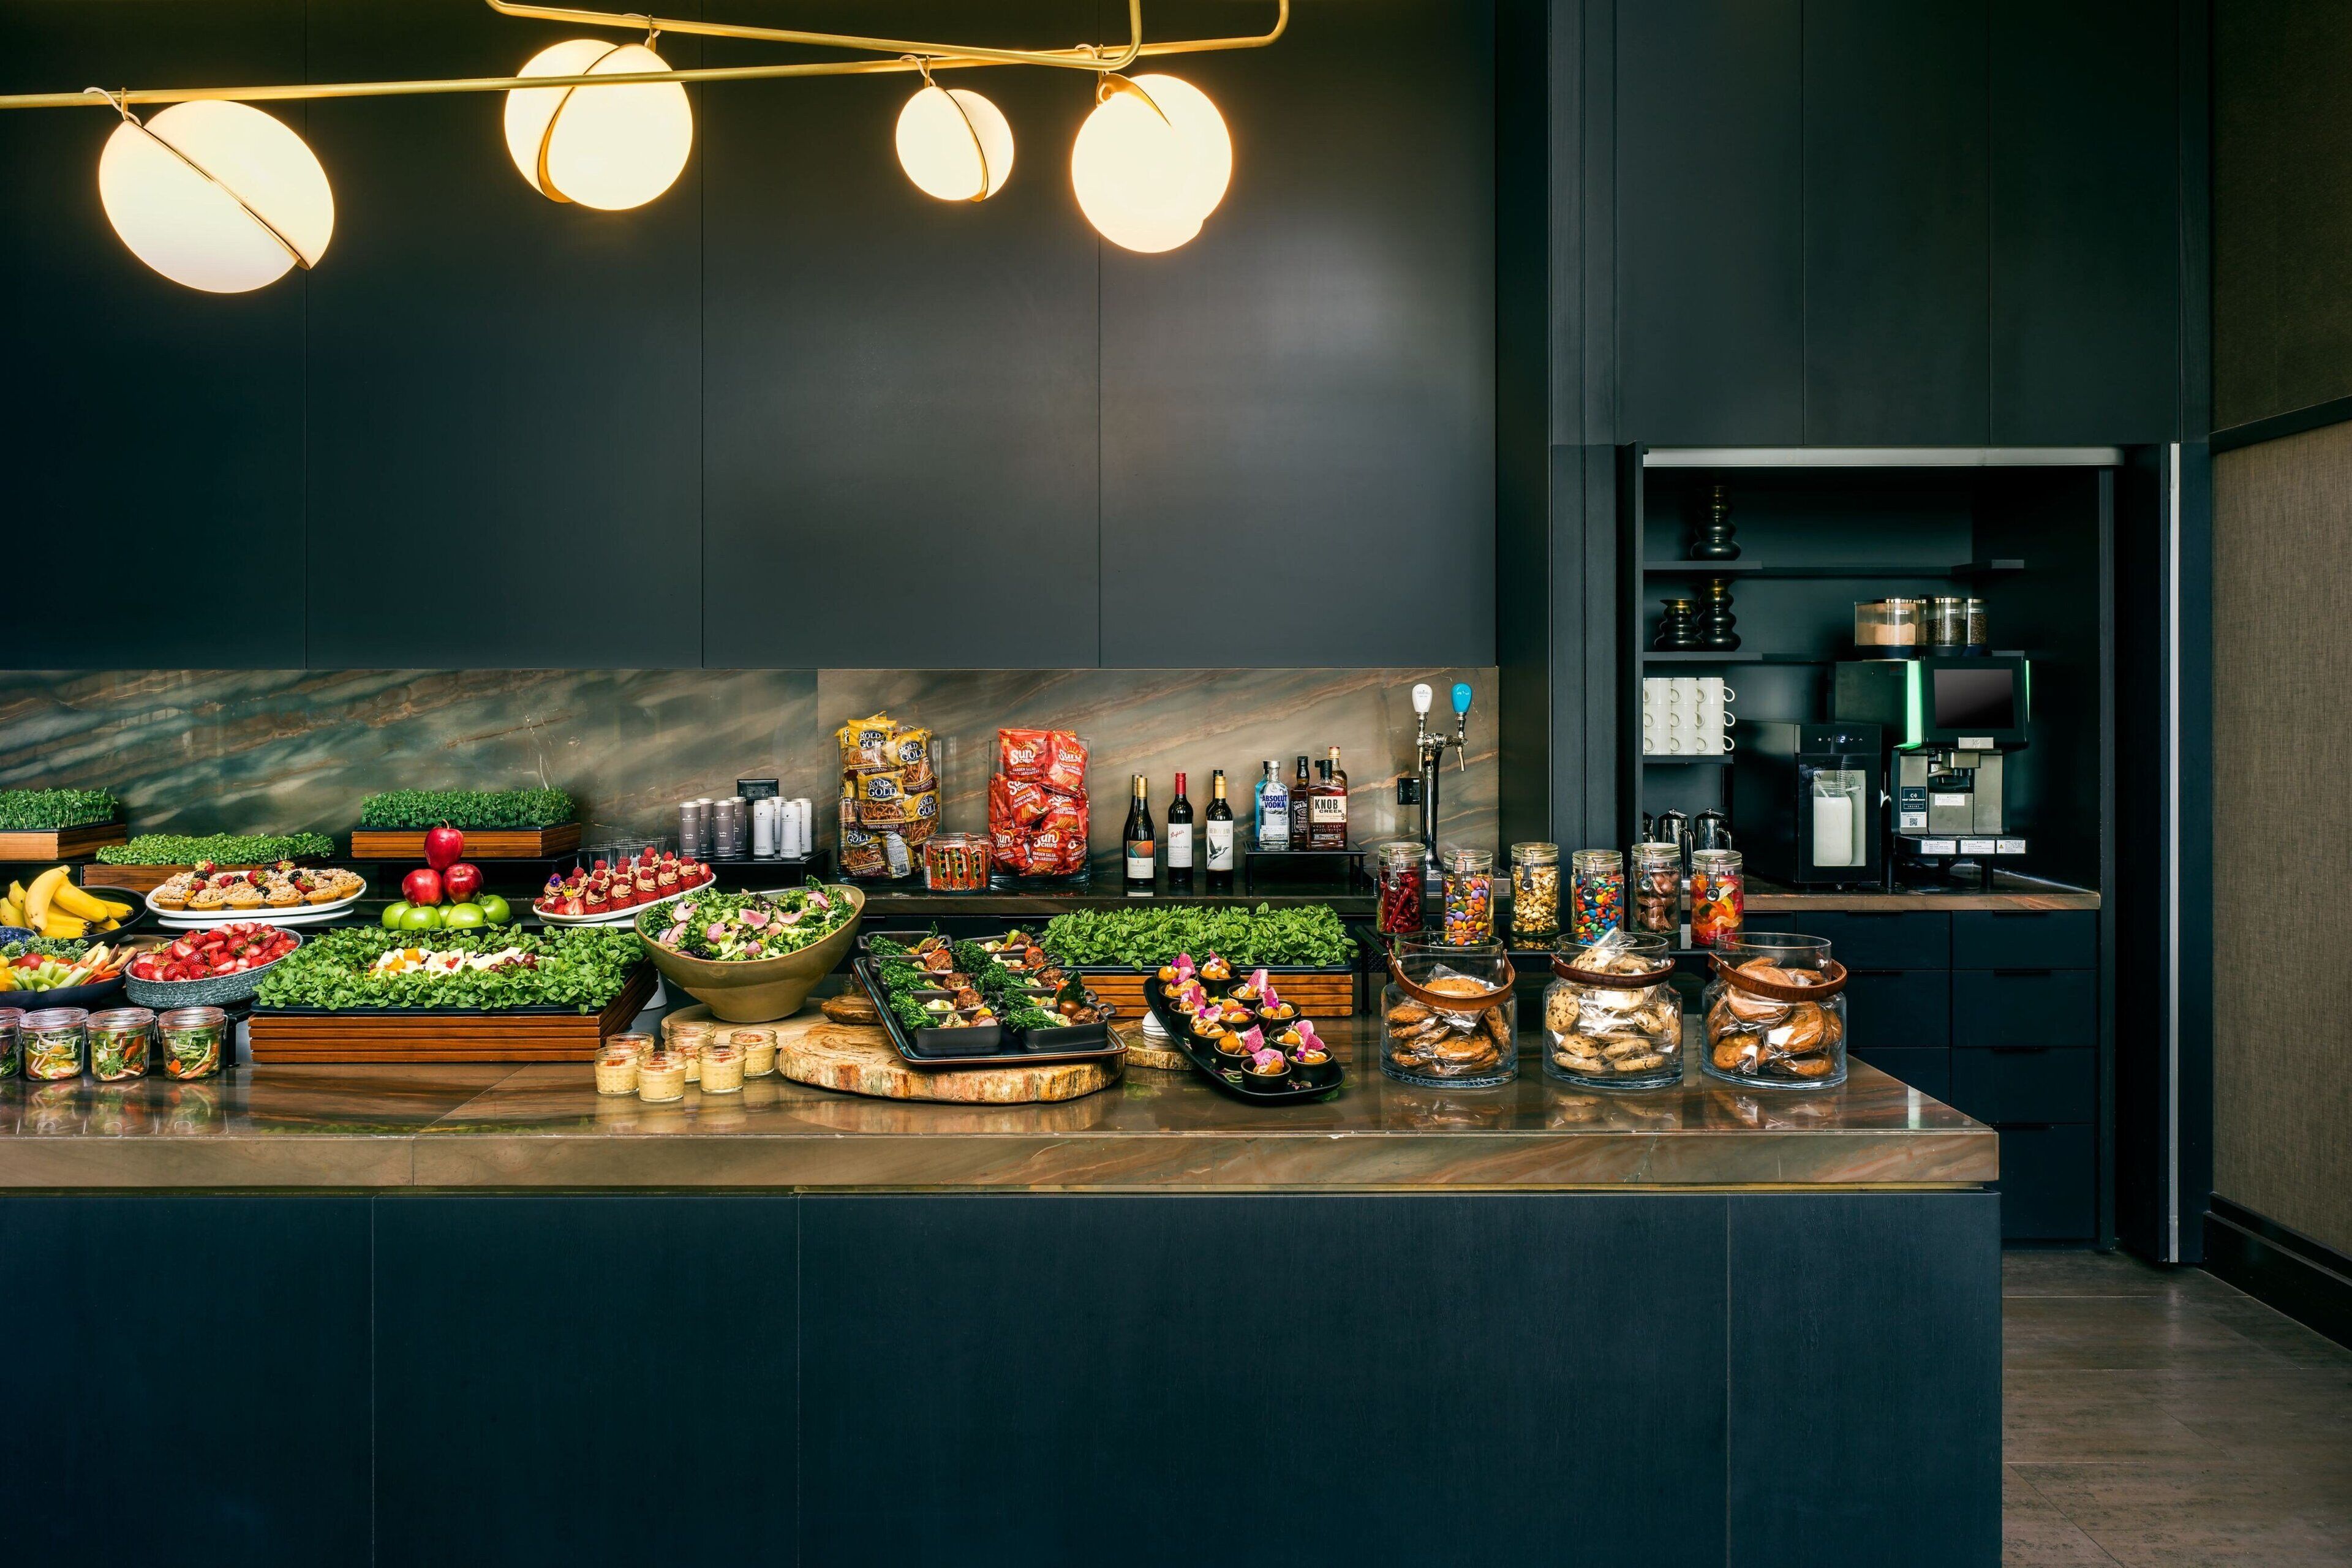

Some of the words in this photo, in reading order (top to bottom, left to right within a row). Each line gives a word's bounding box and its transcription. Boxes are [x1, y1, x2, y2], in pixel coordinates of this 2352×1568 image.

[860, 731, 881, 739] ROLD
[898, 742, 919, 755] ROLD
[900, 748, 926, 761] GOLD
[867, 788, 897, 797] GOLD
[1315, 799, 1338, 809] KNOB
